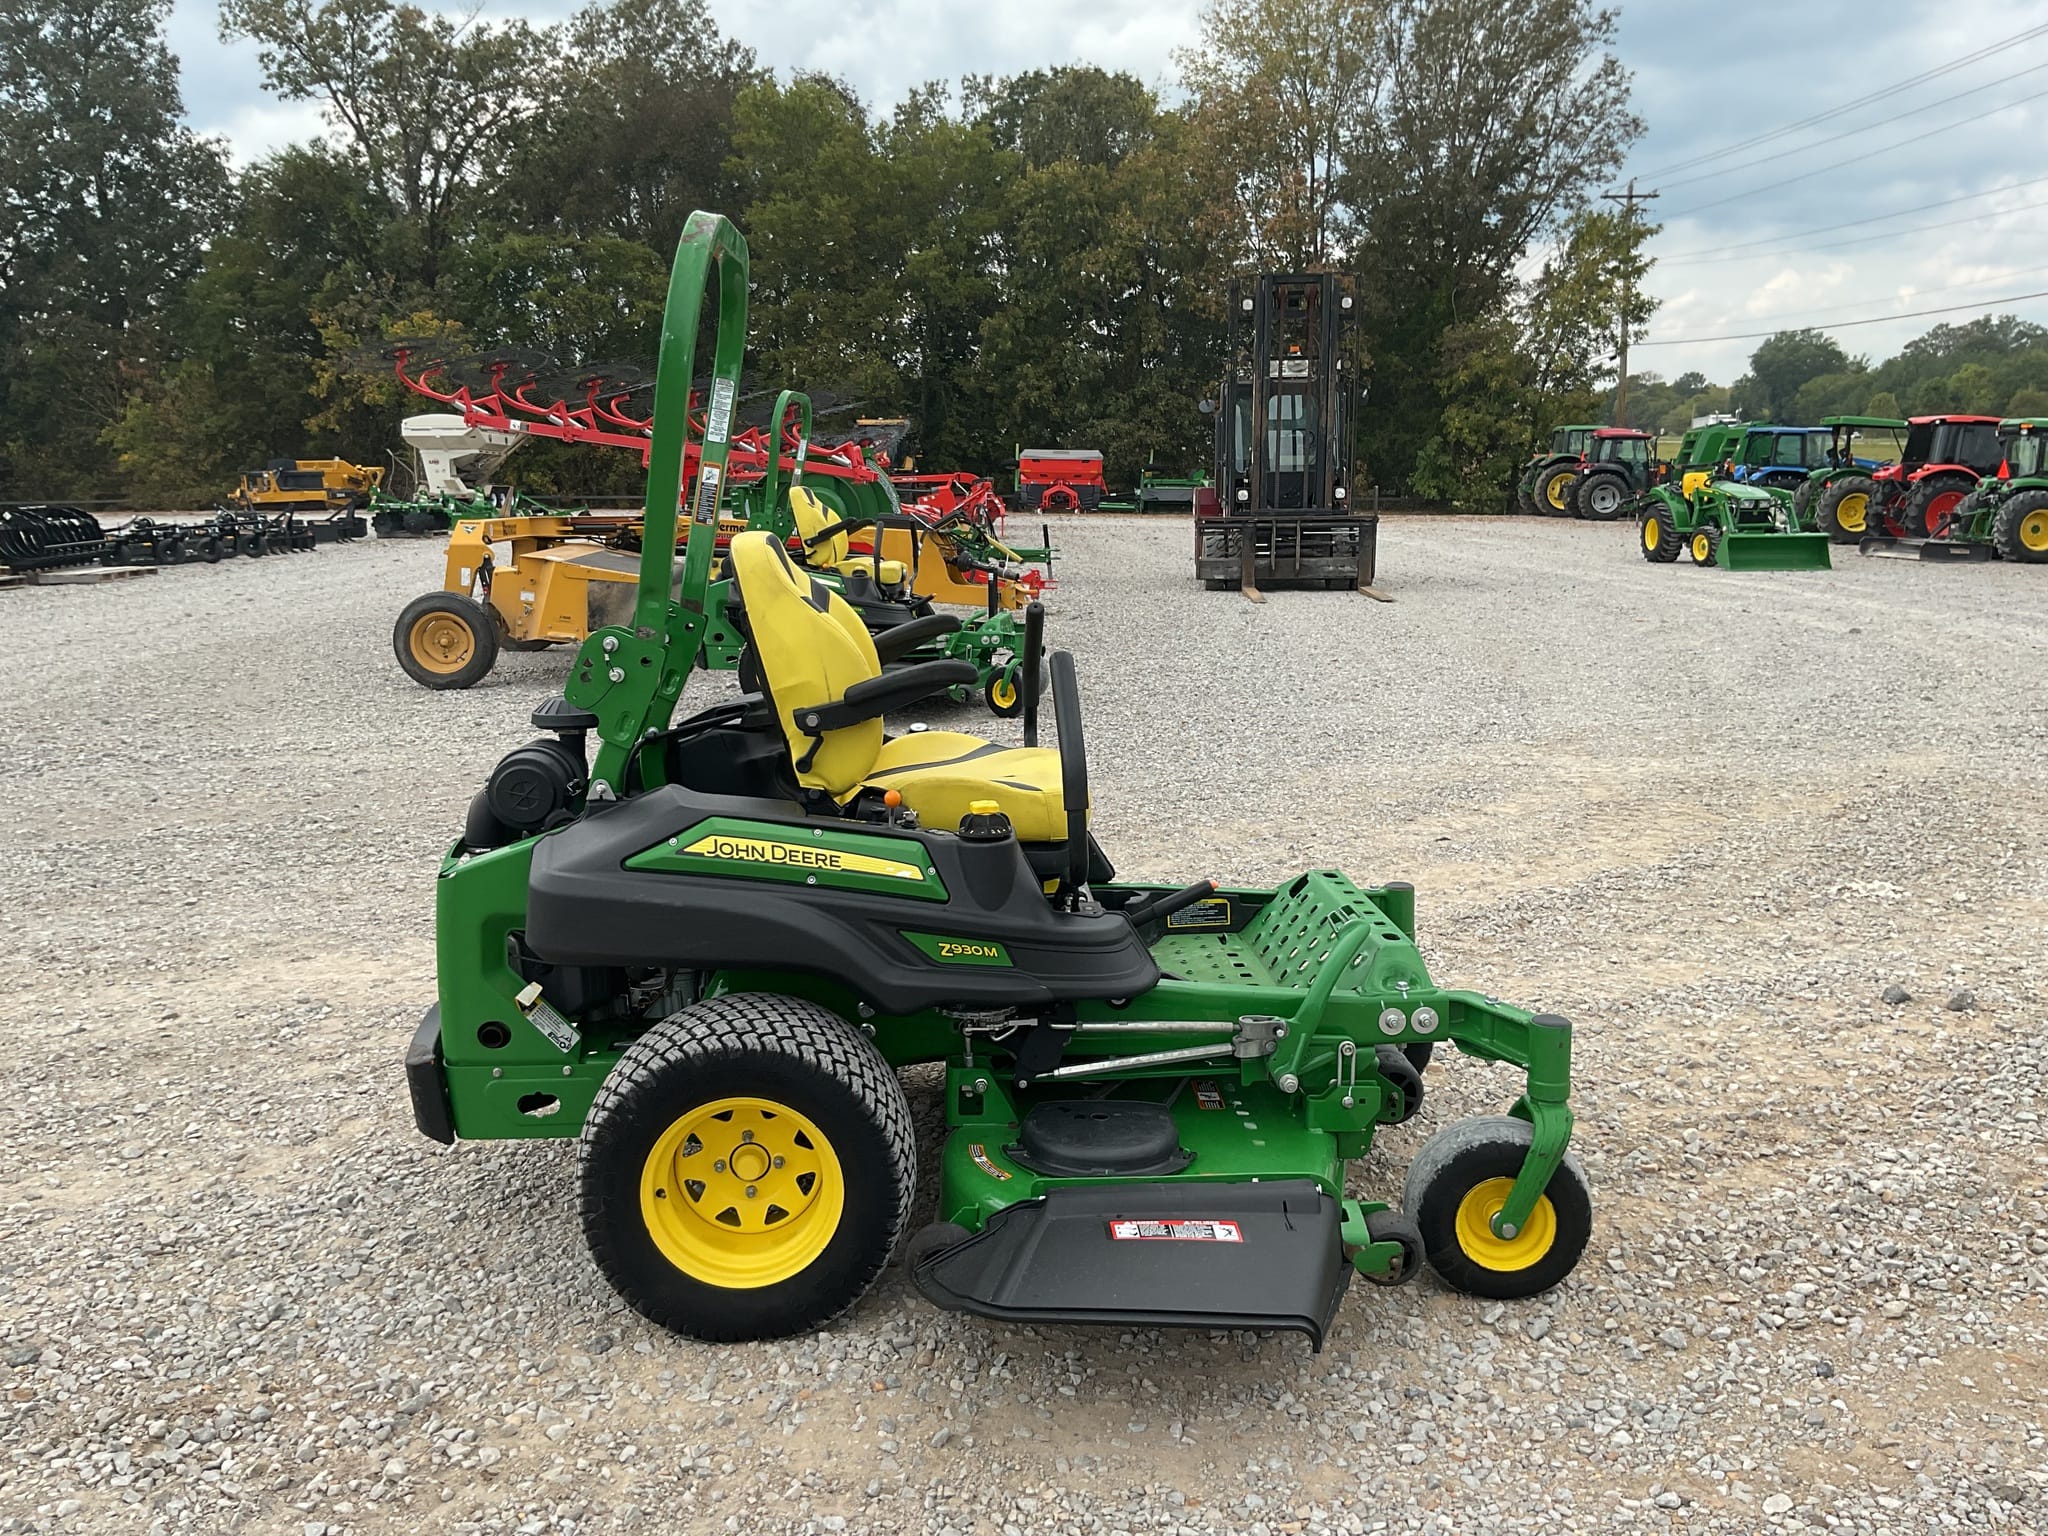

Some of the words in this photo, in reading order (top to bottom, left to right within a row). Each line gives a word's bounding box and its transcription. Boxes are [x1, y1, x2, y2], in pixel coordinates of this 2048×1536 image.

[718, 523, 745, 532] erme
[706, 839, 766, 860] JOHN
[770, 844, 842, 868] DEERE
[937, 942, 998, 957] Z930M
